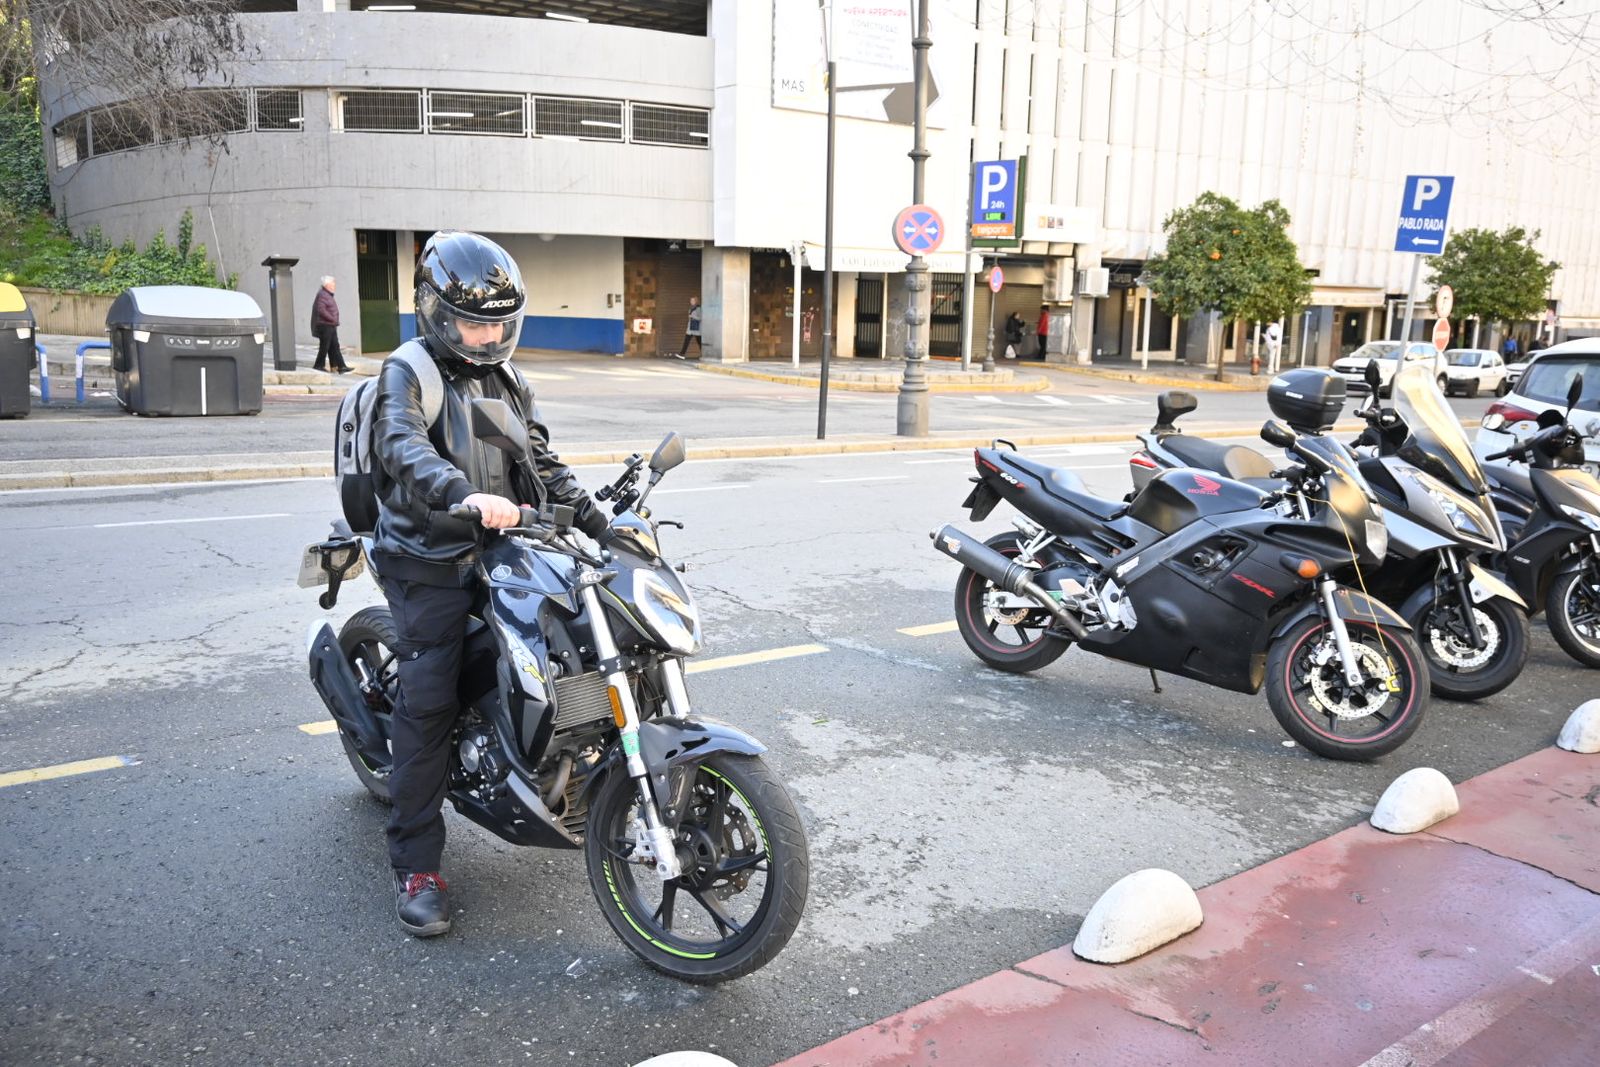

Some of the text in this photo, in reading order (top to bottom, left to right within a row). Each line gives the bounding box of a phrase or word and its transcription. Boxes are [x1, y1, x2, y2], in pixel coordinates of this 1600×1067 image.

[781, 78, 804, 92] MAS
[981, 165, 1008, 209] P
[1413, 178, 1440, 210] P
[991, 201, 1005, 209] 24h
[1399, 217, 1444, 231] PABLO RADA
[1187, 487, 1220, 497] HONDA
